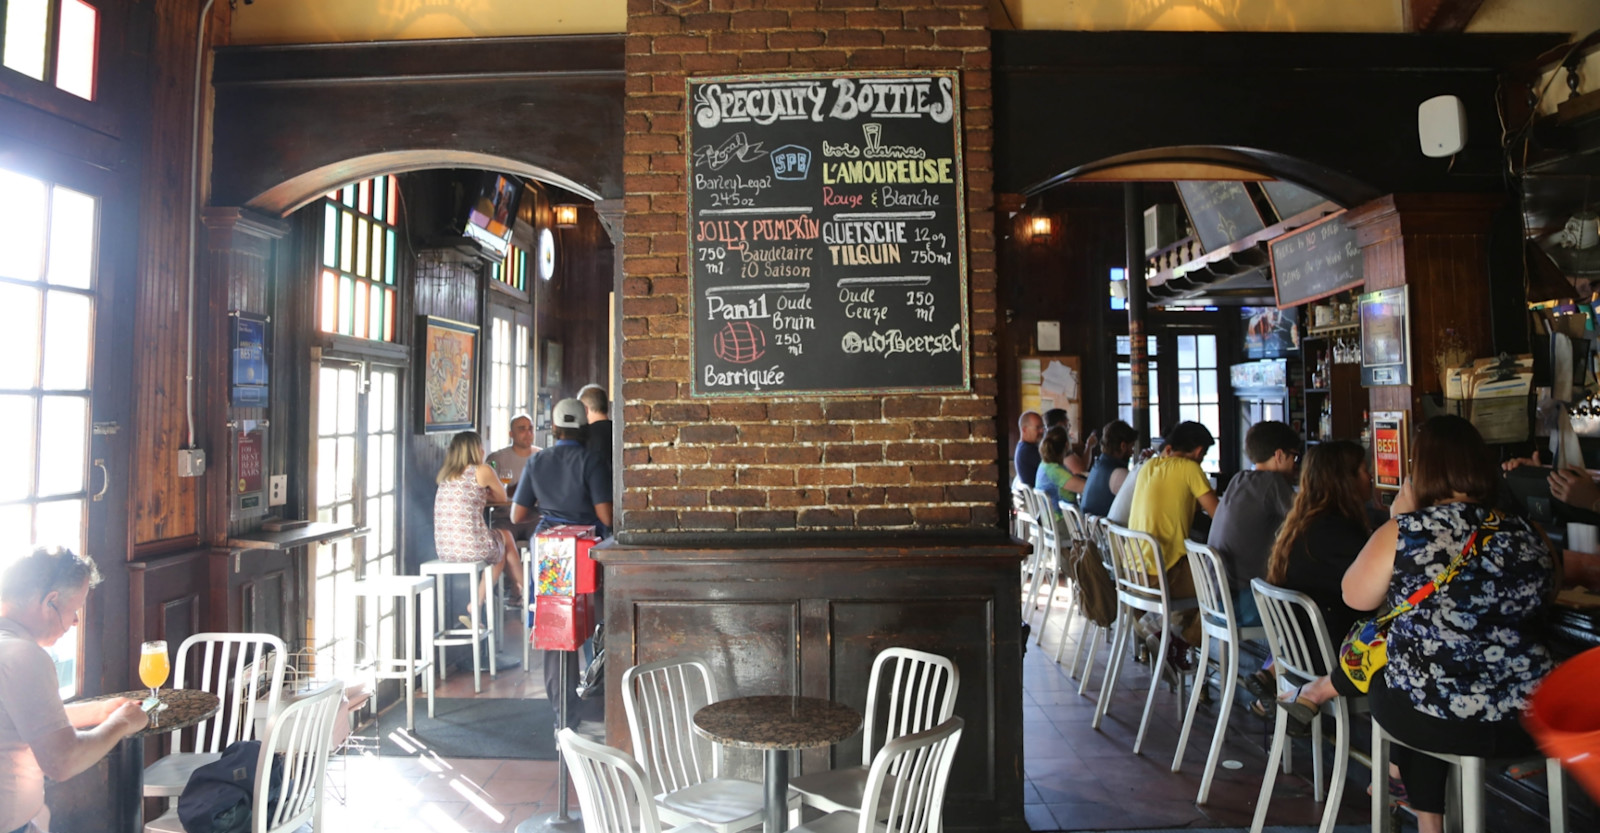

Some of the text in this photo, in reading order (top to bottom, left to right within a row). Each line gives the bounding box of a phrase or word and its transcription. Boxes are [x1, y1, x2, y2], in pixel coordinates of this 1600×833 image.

[695, 77, 953, 128] SPECIALTY BOTTLES
[710, 134, 744, 168] Local
[863, 132, 926, 159] dames
[775, 153, 807, 174] SPB
[823, 158, 954, 184] L'AMOUREUSE
[823, 186, 863, 208] Rouge
[882, 185, 940, 207] Blanche
[697, 214, 819, 250] JOLLY PUMPKIN
[822, 221, 907, 244] QUETSCHE
[1305, 232, 1316, 247] NO
[699, 247, 726, 261] 750
[739, 240, 813, 262] Baudelaire
[828, 243, 901, 265] TILQUIN
[705, 261, 724, 275] ml
[764, 261, 811, 277] Saison
[777, 294, 812, 310] Oude
[839, 287, 875, 303] Oude
[706, 293, 771, 320] Panil
[915, 305, 935, 322] ml
[773, 311, 816, 331] Bruin
[788, 343, 803, 356] ml
[704, 364, 785, 390] Barriquée
[1377, 439, 1397, 453] BEST
